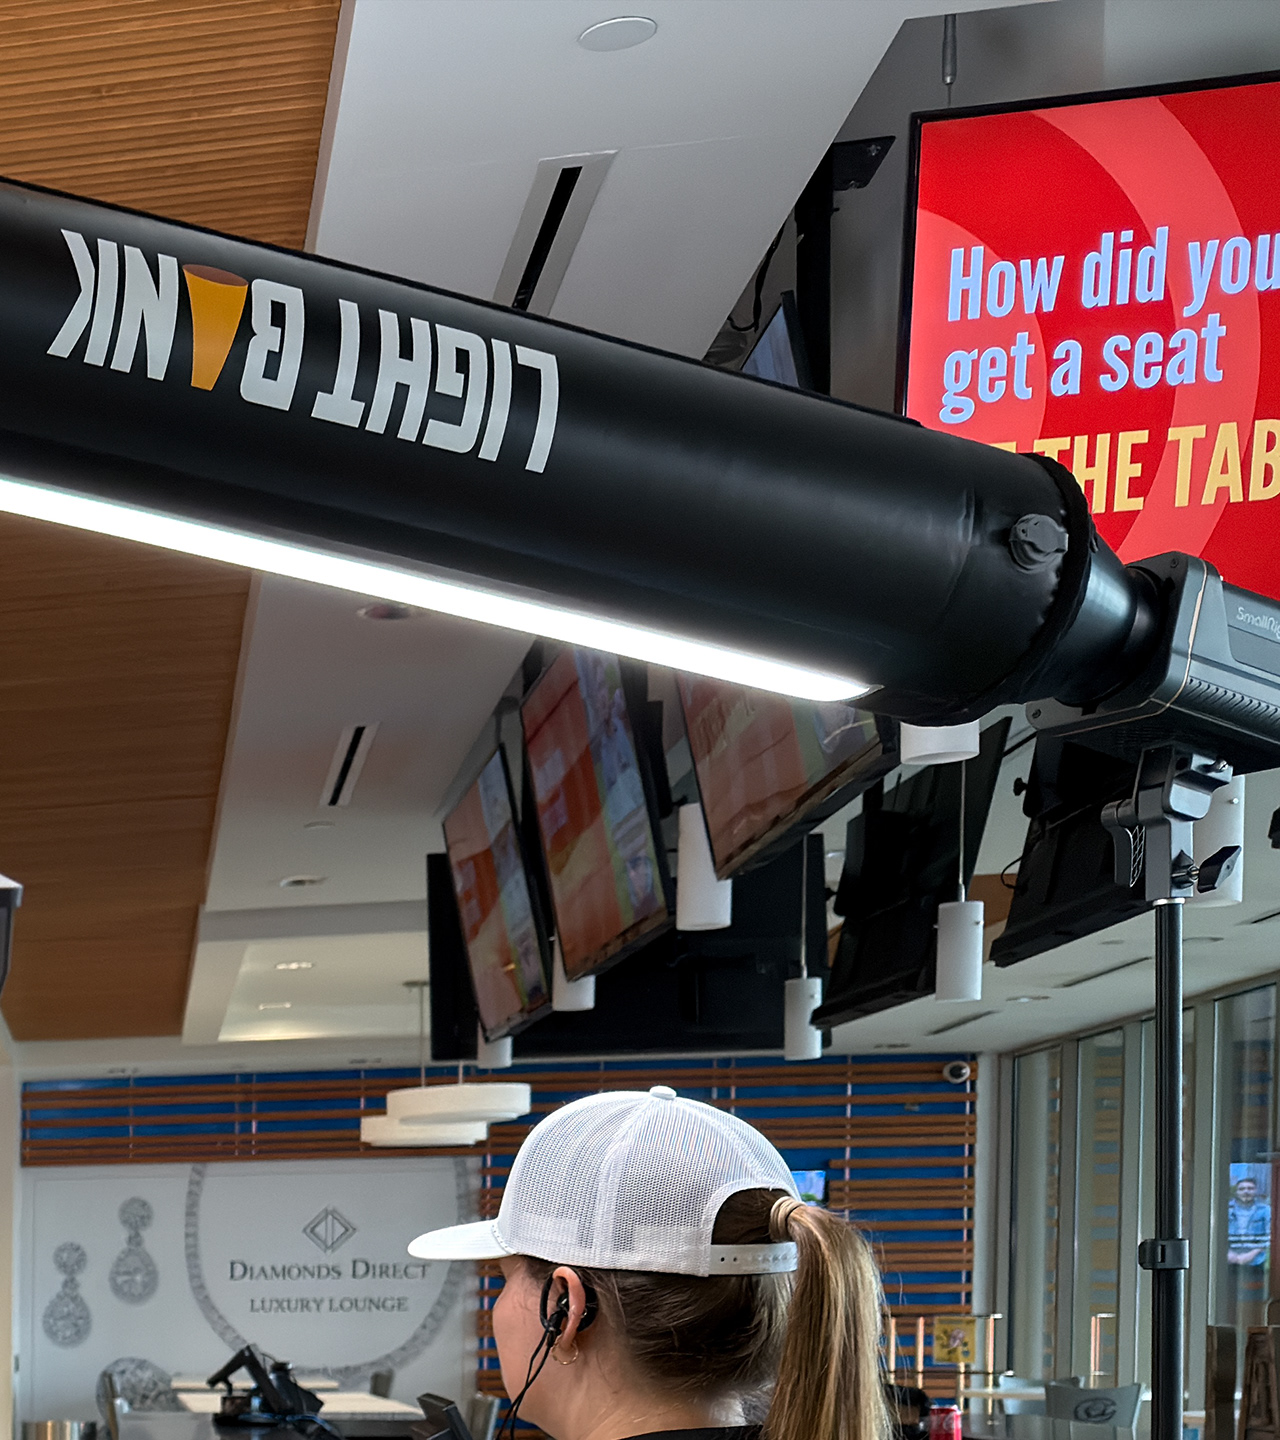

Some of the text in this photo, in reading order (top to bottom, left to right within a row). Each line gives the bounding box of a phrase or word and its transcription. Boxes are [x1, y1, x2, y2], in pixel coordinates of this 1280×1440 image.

[947, 226, 1280, 322] How did you
[311, 298, 559, 474] LIGHT
[939, 312, 1226, 424] get a seat
[229, 1257, 431, 1281] DIAMONDS DIRECT
[250, 1296, 409, 1313] LUXURY LOUNGE
